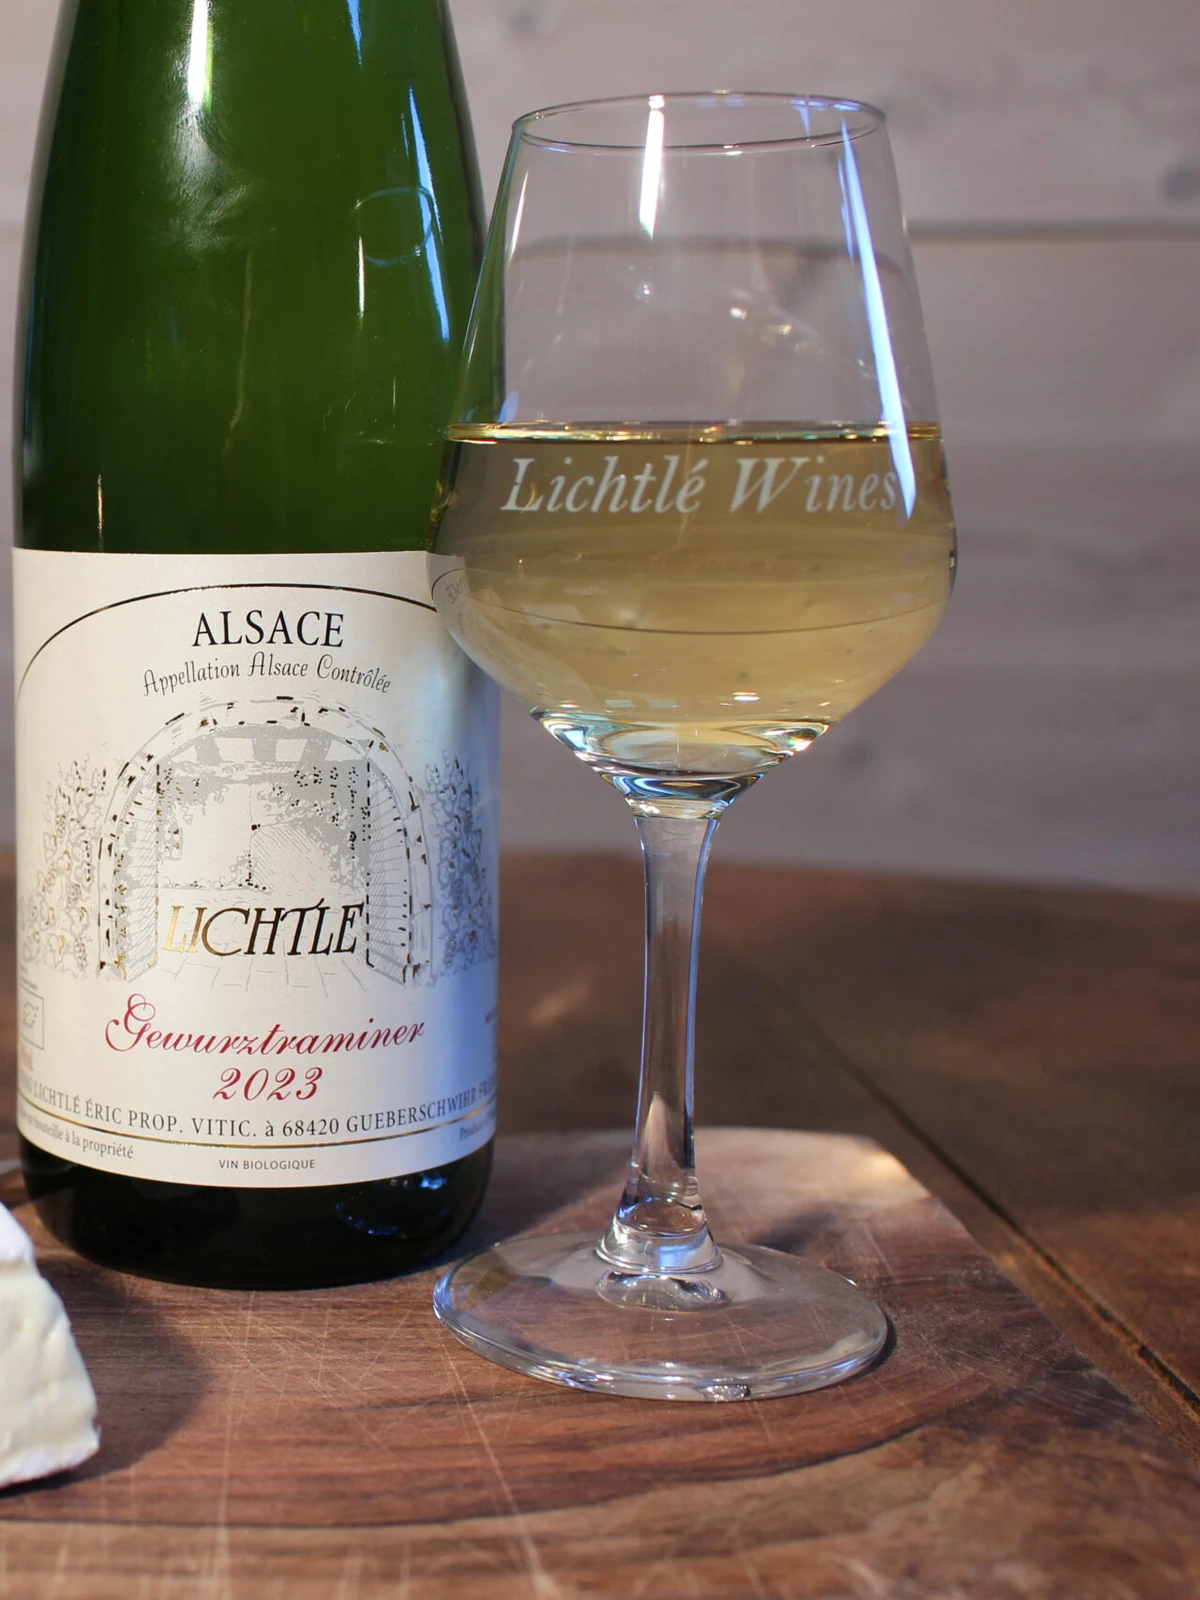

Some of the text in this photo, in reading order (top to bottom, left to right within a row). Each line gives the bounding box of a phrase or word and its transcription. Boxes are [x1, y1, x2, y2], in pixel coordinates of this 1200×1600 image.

[500, 455, 899, 513] Lichtlé Wines
[192, 610, 344, 648] ALSACE
[143, 651, 391, 696] Appellation Alsace Contrôlée
[105, 993, 425, 1055] Gewurztraminer
[212, 1066, 323, 1101] 2023
[33, 1081, 81, 1115] LICHTLÉ
[85, 1098, 122, 1125] ÉRIC
[128, 1109, 183, 1134] PROP.
[191, 1117, 256, 1137] VITIC.
[264, 1120, 274, 1138] à
[282, 1118, 340, 1137] 68420
[82, 1138, 135, 1159] propriété
[218, 1159, 317, 1172] VIN BIOLOGIQUE
